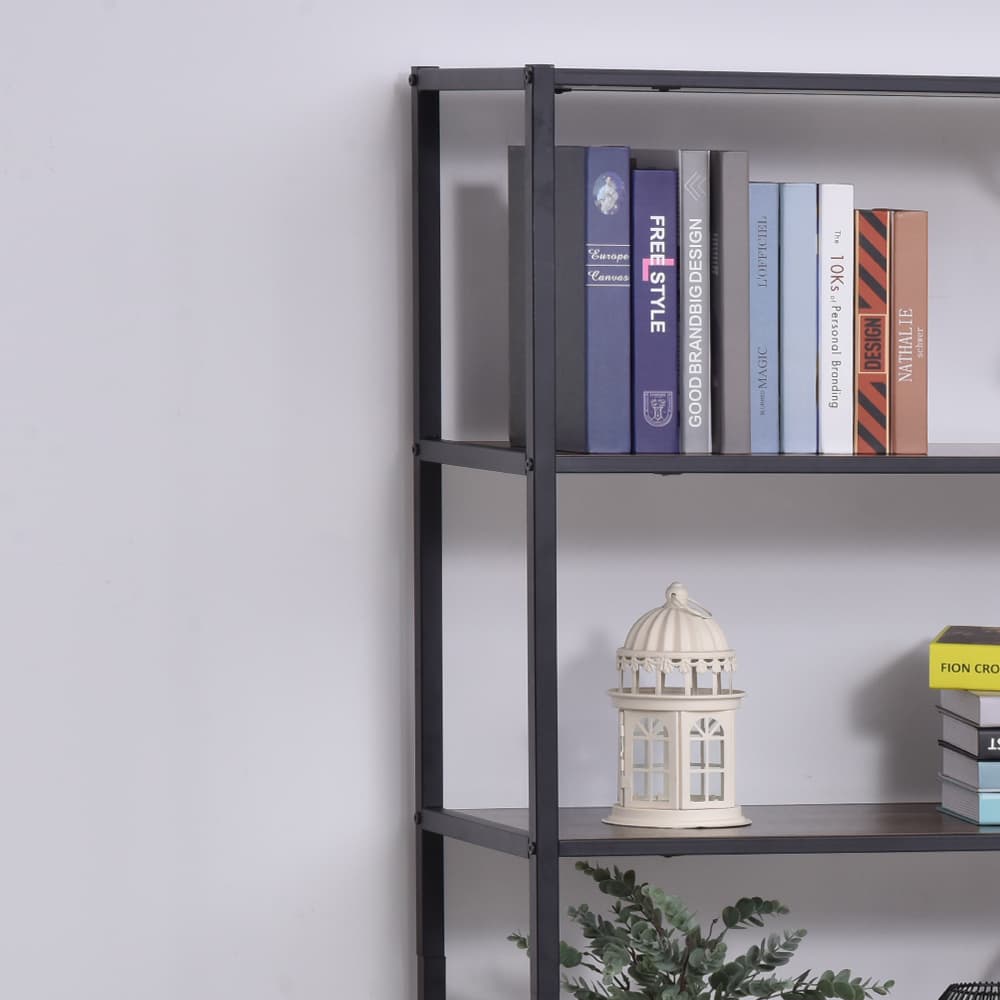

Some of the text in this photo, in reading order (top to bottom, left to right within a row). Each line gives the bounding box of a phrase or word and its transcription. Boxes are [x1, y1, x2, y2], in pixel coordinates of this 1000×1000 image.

[587, 248, 630, 263] Europe
[688, 218, 703, 283] DESIGN
[834, 230, 842, 244] The
[587, 270, 630, 282] Canvas
[649, 215, 666, 333] FREE STYLE
[830, 255, 845, 292] 10Ks
[831, 305, 843, 355] Personal
[863, 317, 883, 371] DESIGN
[688, 377, 703, 428] GOOD
[828, 360, 843, 409] Branding
[940, 662, 971, 674] FION
